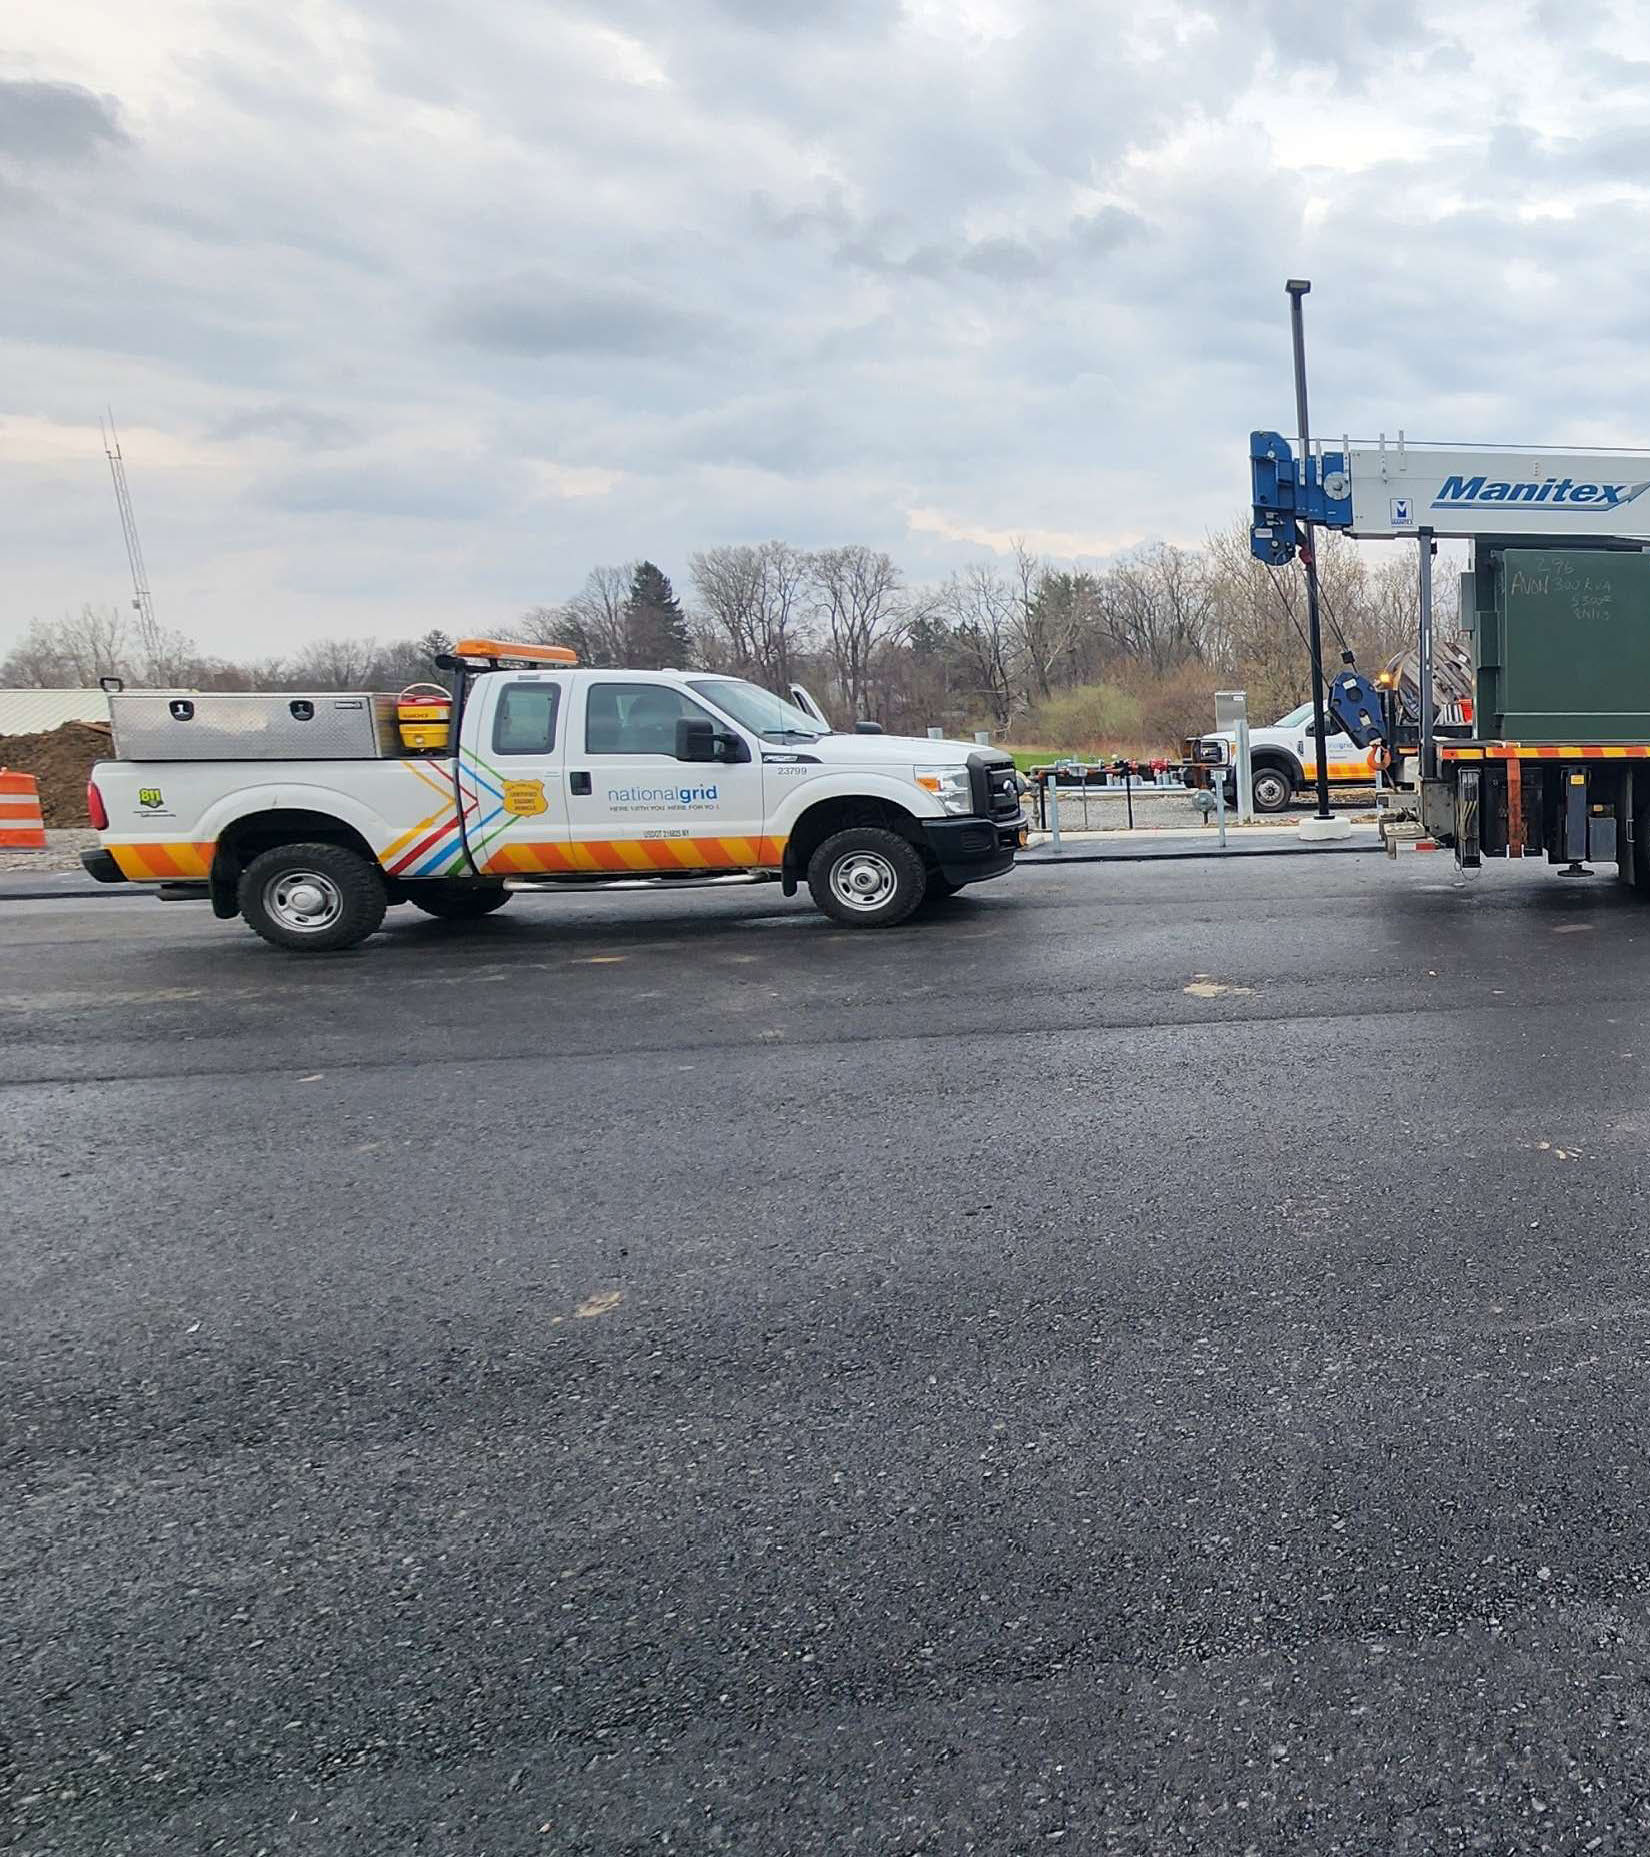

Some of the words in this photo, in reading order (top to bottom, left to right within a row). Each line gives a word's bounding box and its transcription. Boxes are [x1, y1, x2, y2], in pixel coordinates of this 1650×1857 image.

[1437, 476, 1627, 503] Manitex
[1511, 570, 1549, 596] AVON
[777, 767, 807, 775] 23799
[141, 790, 160, 801] 811
[608, 784, 718, 803] nationalgrid
